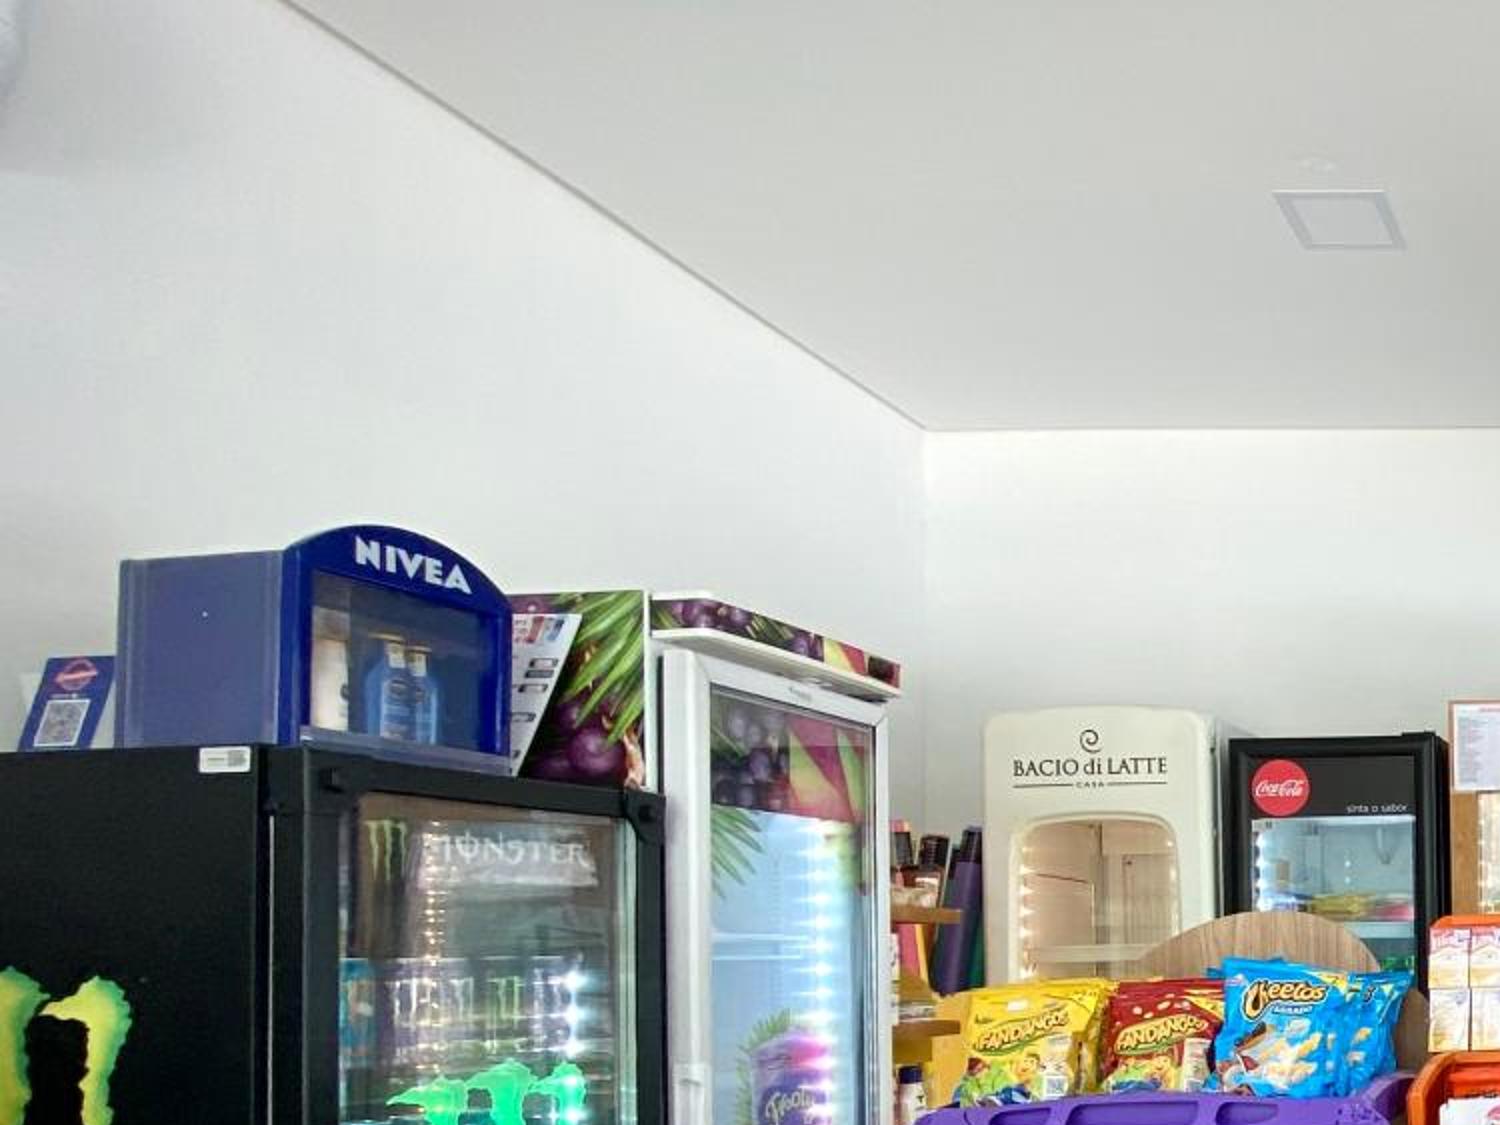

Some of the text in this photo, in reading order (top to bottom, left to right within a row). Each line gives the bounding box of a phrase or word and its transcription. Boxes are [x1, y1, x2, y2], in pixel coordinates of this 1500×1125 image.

[355, 535, 473, 595] NIVEA
[1012, 756, 1168, 777] BACIO di LATTE
[1255, 779, 1305, 798] Coca-Cola
[1243, 981, 1327, 1020] Cheetos
[978, 1008, 1069, 1051] FANDANGOS
[1114, 1015, 1208, 1051] FANDANGOS
